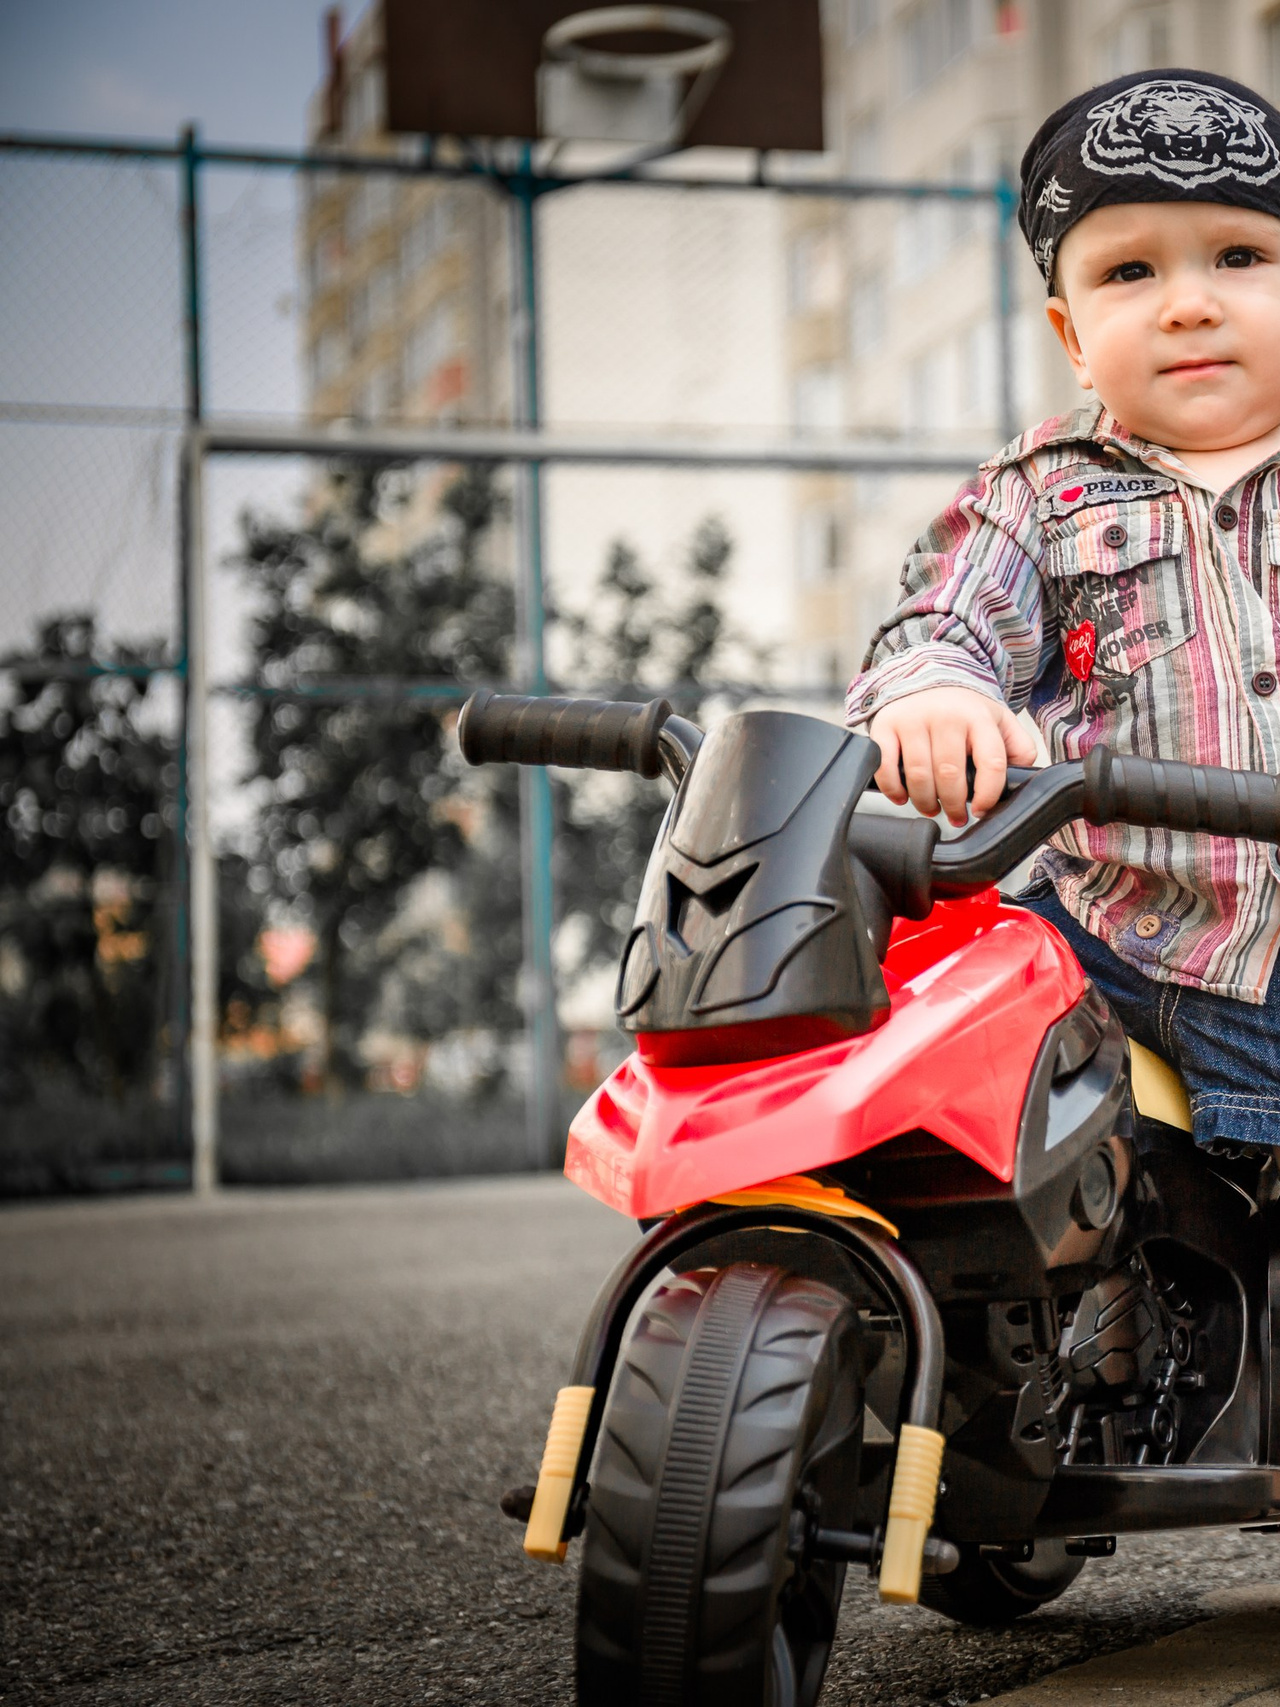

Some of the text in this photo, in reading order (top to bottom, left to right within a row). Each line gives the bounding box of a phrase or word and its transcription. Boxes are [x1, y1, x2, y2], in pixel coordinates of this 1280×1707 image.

[1046, 479, 1157, 513] I PEACE
[1096, 619, 1173, 664] WONDER
